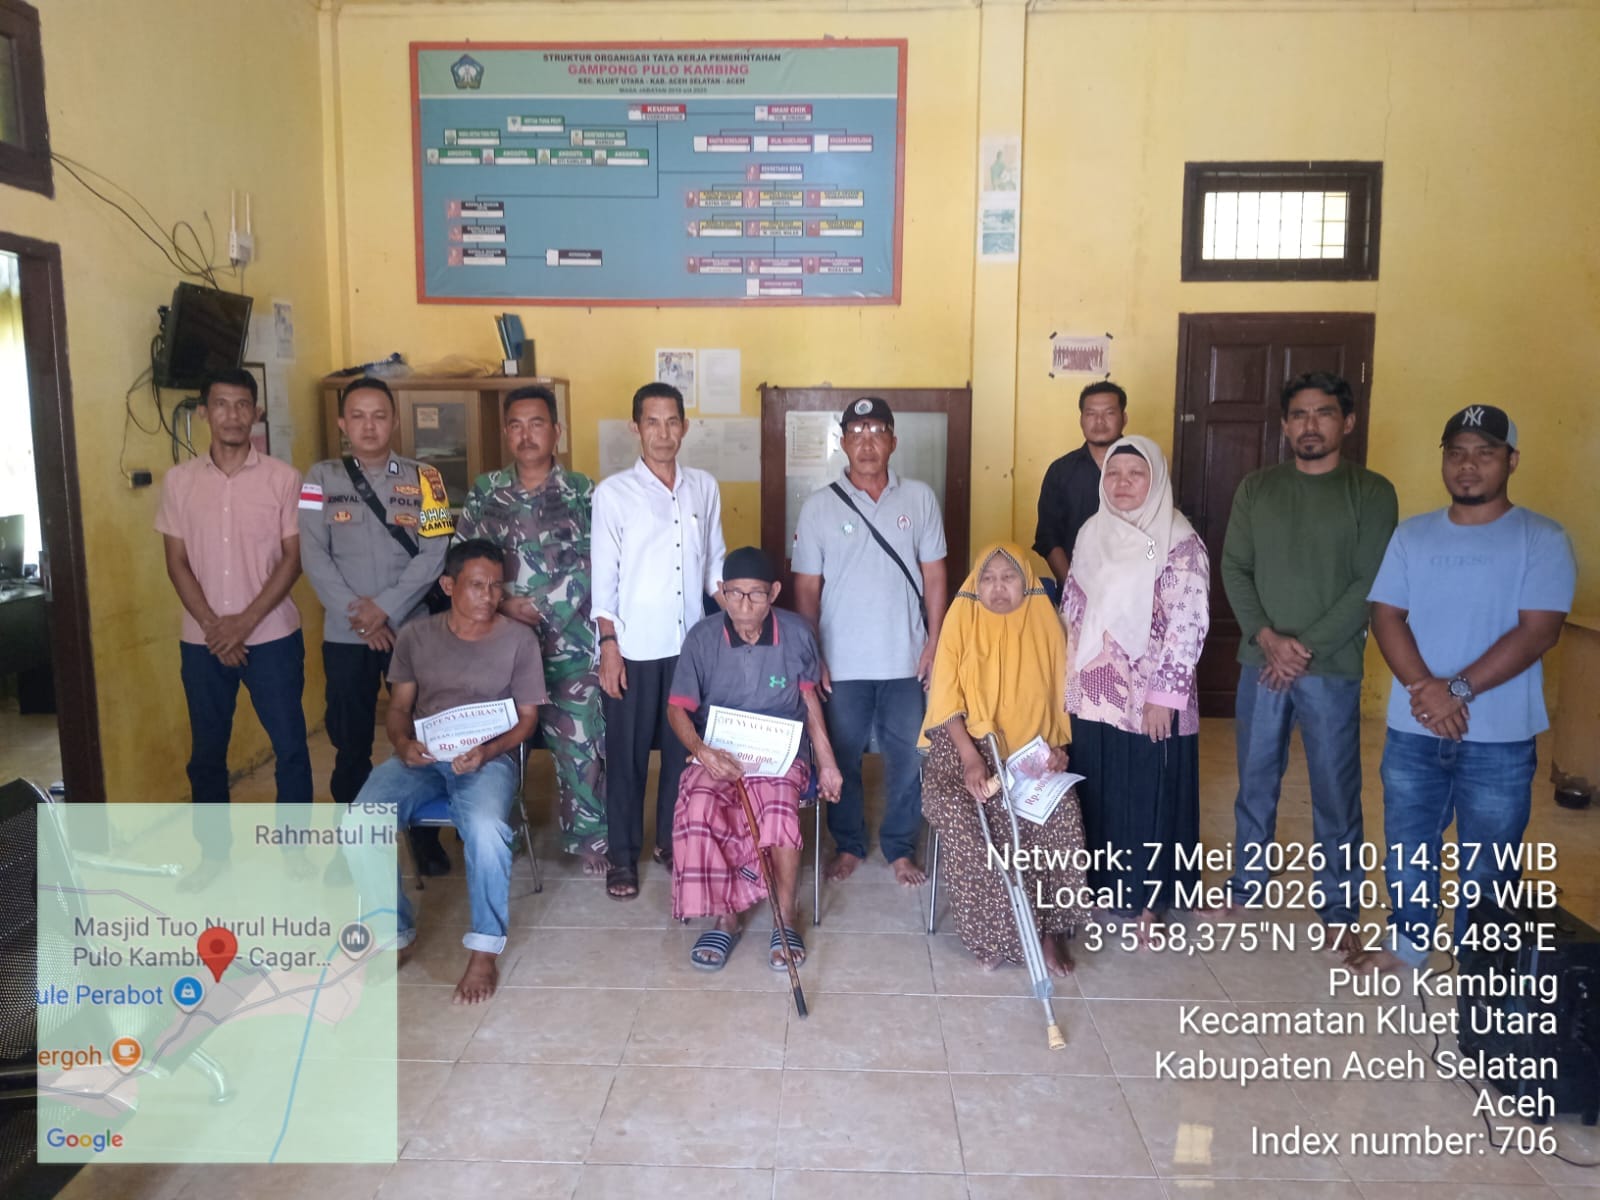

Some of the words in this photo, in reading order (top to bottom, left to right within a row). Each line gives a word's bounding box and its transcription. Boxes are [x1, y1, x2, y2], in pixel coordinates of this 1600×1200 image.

[543, 54, 592, 62] STRUKTUR
[595, 54, 650, 62] ORGANISASI
[654, 54, 675, 62] TATA
[677, 54, 707, 62] KERJA
[710, 53, 781, 62] PEMERINTAHAN
[568, 64, 638, 75] GAMPONG
[642, 64, 680, 75] PULO
[683, 64, 749, 75] KAMBING
[647, 105, 680, 113] KEUCHIK
[439, 743, 458, 751] Rp.
